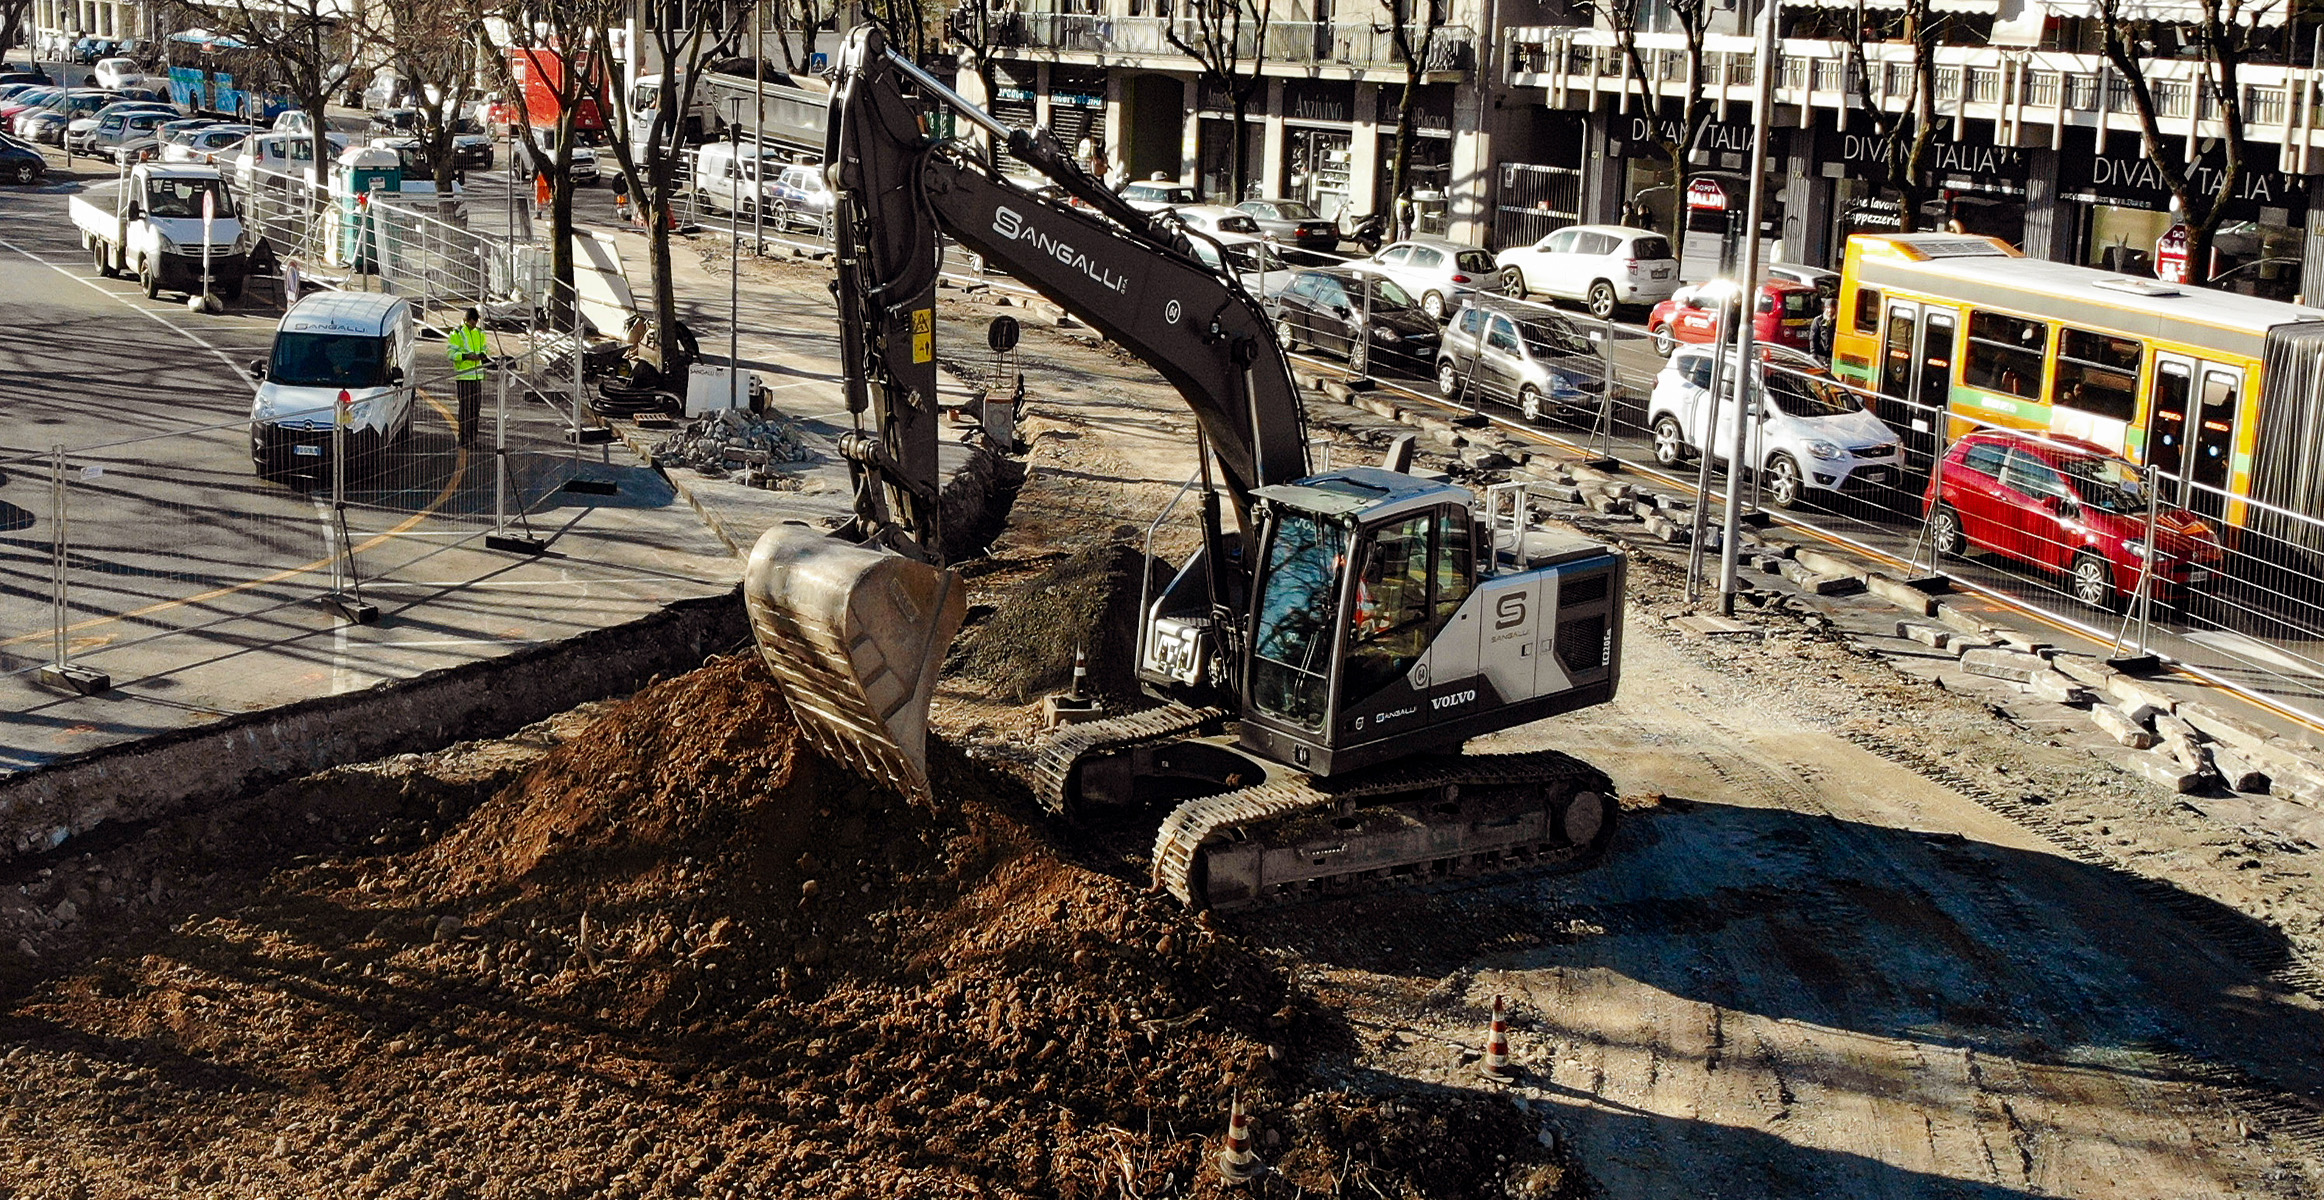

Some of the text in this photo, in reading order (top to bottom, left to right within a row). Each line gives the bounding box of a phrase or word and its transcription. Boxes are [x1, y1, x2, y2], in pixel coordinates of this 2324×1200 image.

[1687, 191, 1723, 207] SALDI
[1849, 213, 1901, 226] appezzeria
[992, 205, 1123, 292] SANGALLI
[1431, 689, 1476, 710] VOLVO
